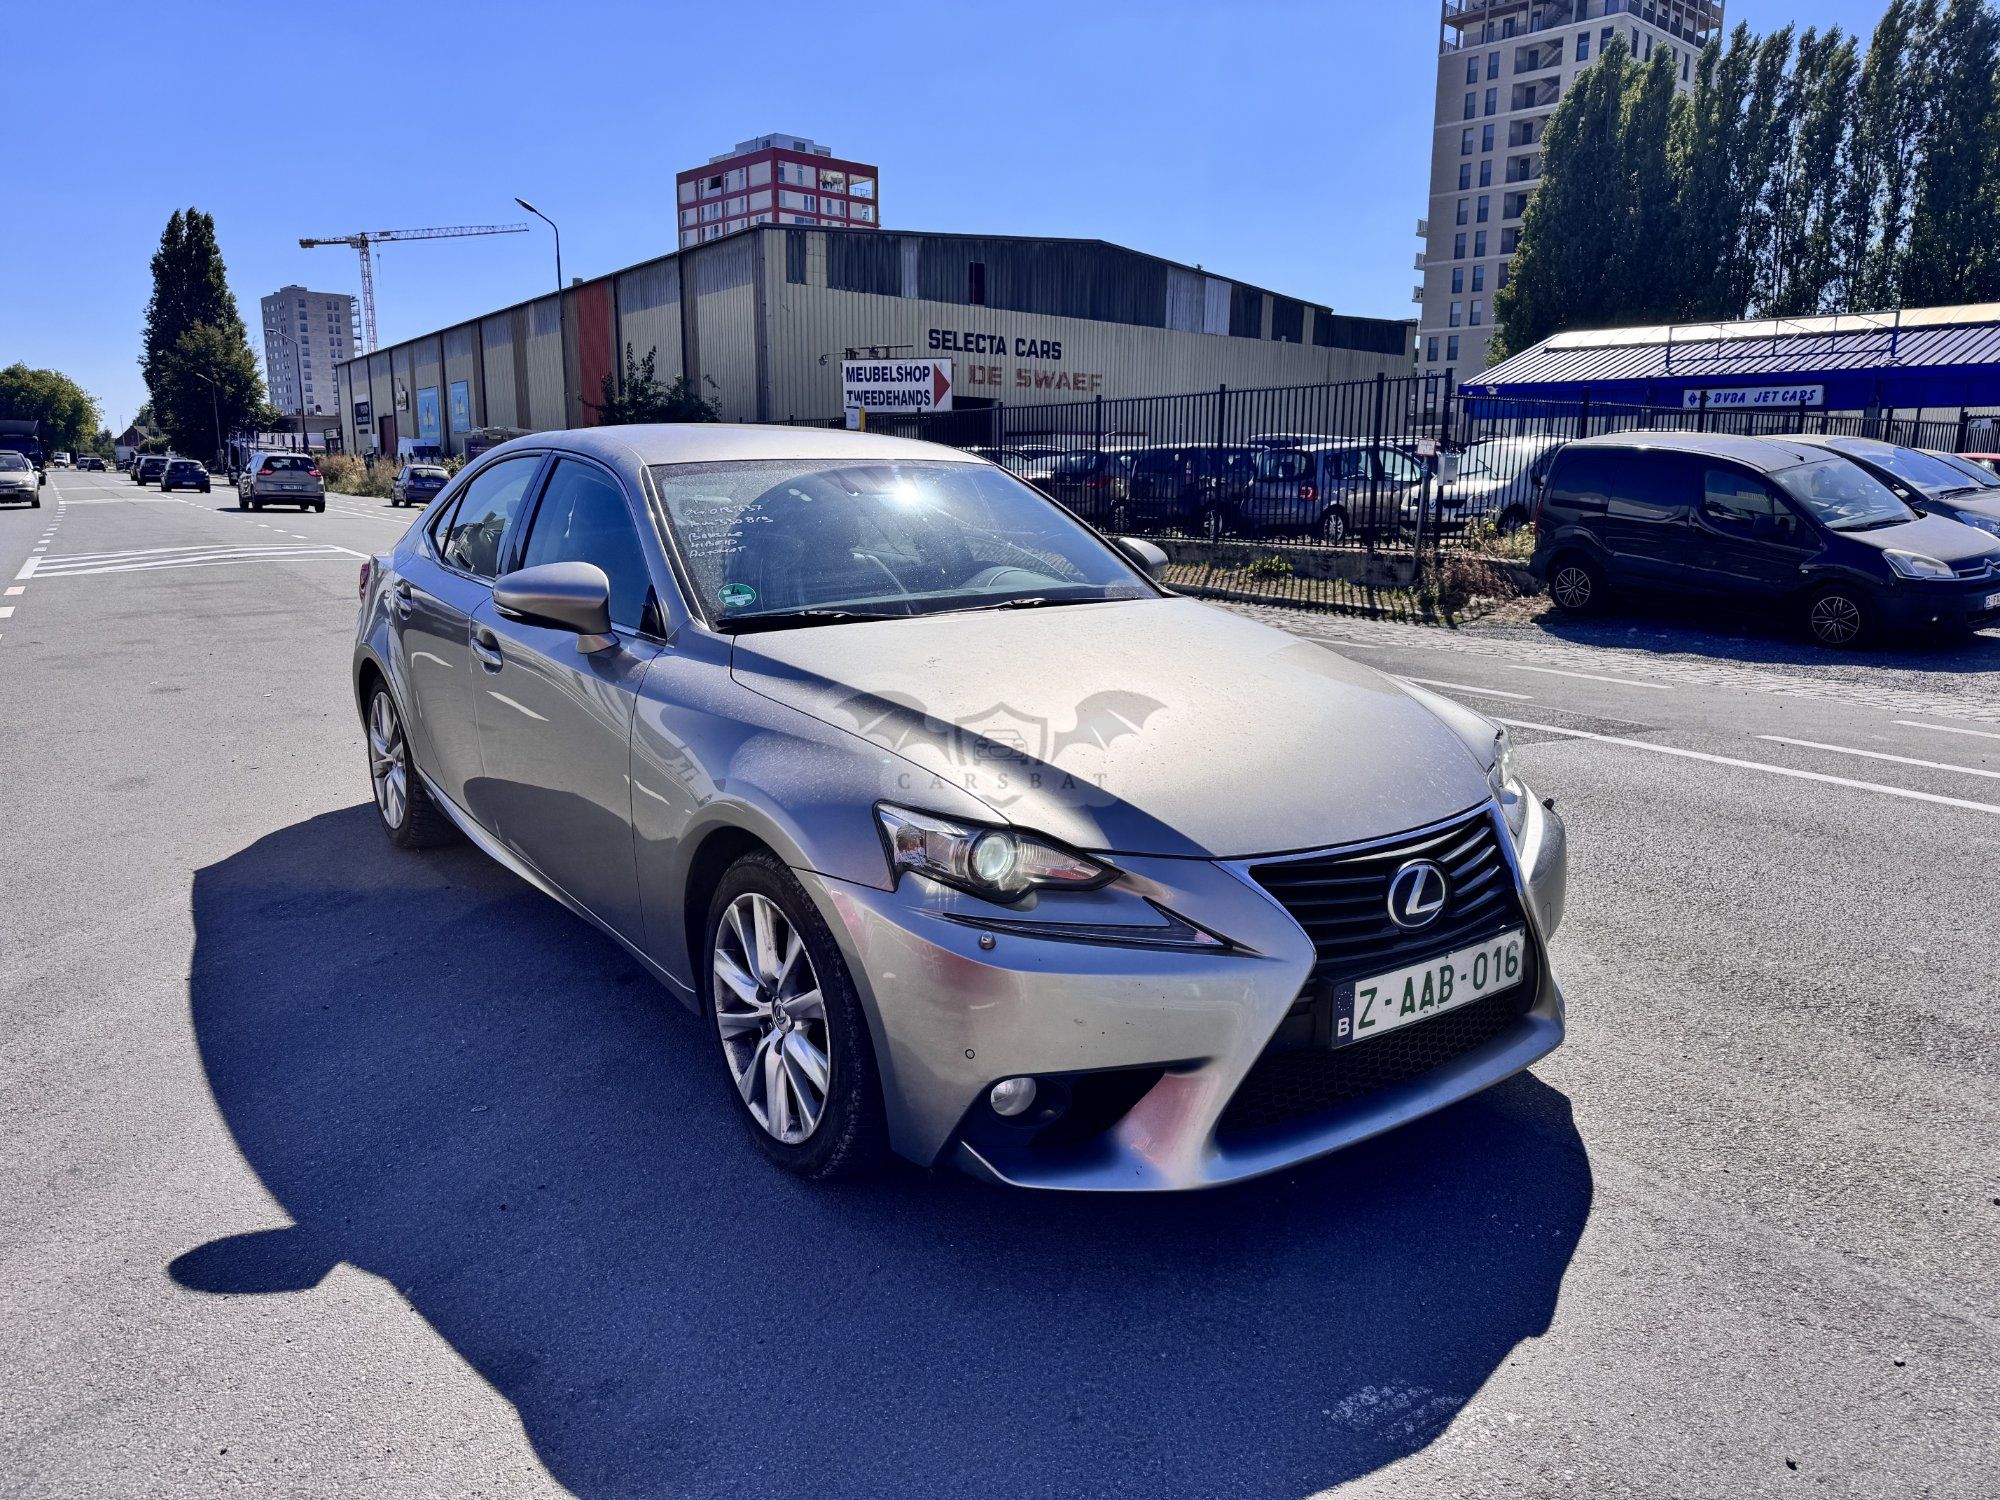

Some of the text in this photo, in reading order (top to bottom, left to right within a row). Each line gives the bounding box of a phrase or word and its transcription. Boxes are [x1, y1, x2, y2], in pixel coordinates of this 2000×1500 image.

[928, 328, 1062, 360] SELECTA CARS
[845, 366, 931, 383] MEUBELSHOP
[968, 363, 1003, 386] DE
[846, 389, 931, 406] TWEEDEHANDS
[1713, 392, 1746, 404] BVBA
[1753, 390, 1780, 403] JET
[1357, 939, 1520, 1030] Z-AAB-016
[1337, 1016, 1350, 1037] B
